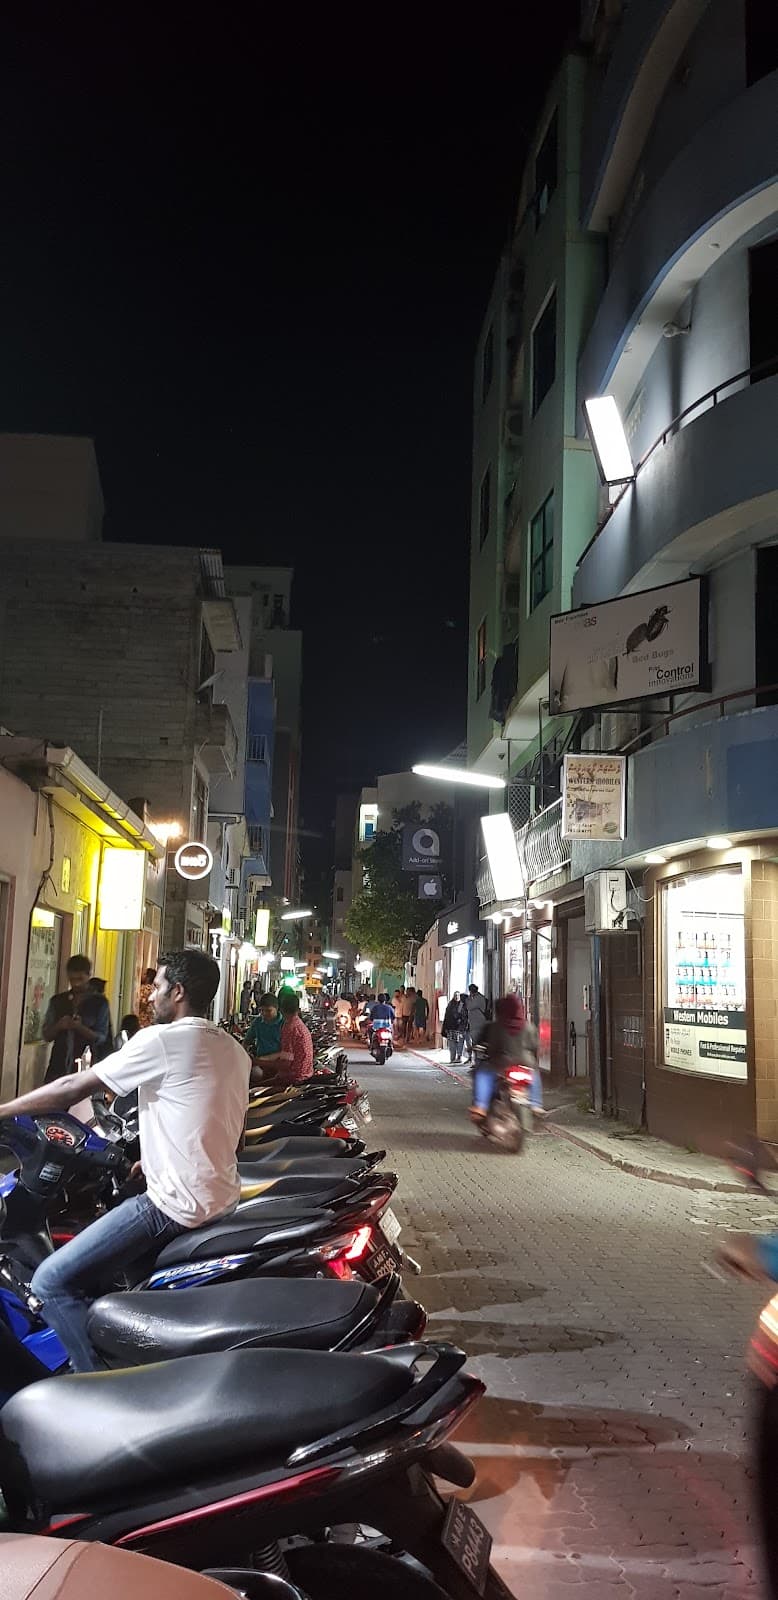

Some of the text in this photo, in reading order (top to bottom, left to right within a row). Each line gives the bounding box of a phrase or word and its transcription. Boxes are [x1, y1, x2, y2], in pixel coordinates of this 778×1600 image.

[656, 662, 694, 680] Control
[673, 1010, 729, 1026] Western Mobiles
[462, 1518, 484, 1579] P8443
